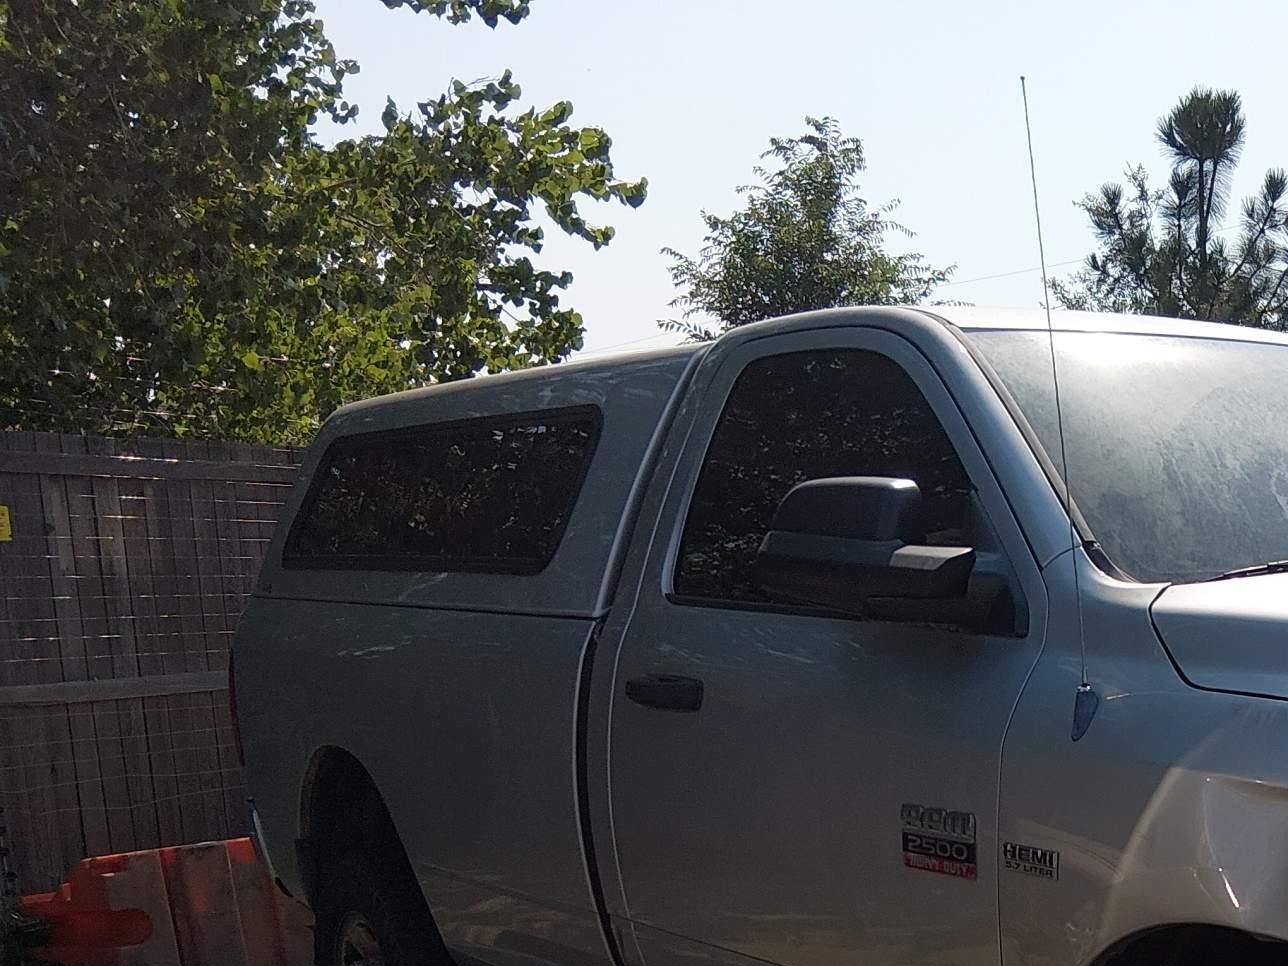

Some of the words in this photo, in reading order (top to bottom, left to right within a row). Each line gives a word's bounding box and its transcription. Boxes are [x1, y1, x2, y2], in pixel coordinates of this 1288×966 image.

[907, 835, 968, 860] 2500
[1003, 842, 1057, 869] HEMI
[943, 860, 970, 877] DUTY
[1005, 860, 1020, 872] 5.7
[1023, 864, 1054, 879] LITER
